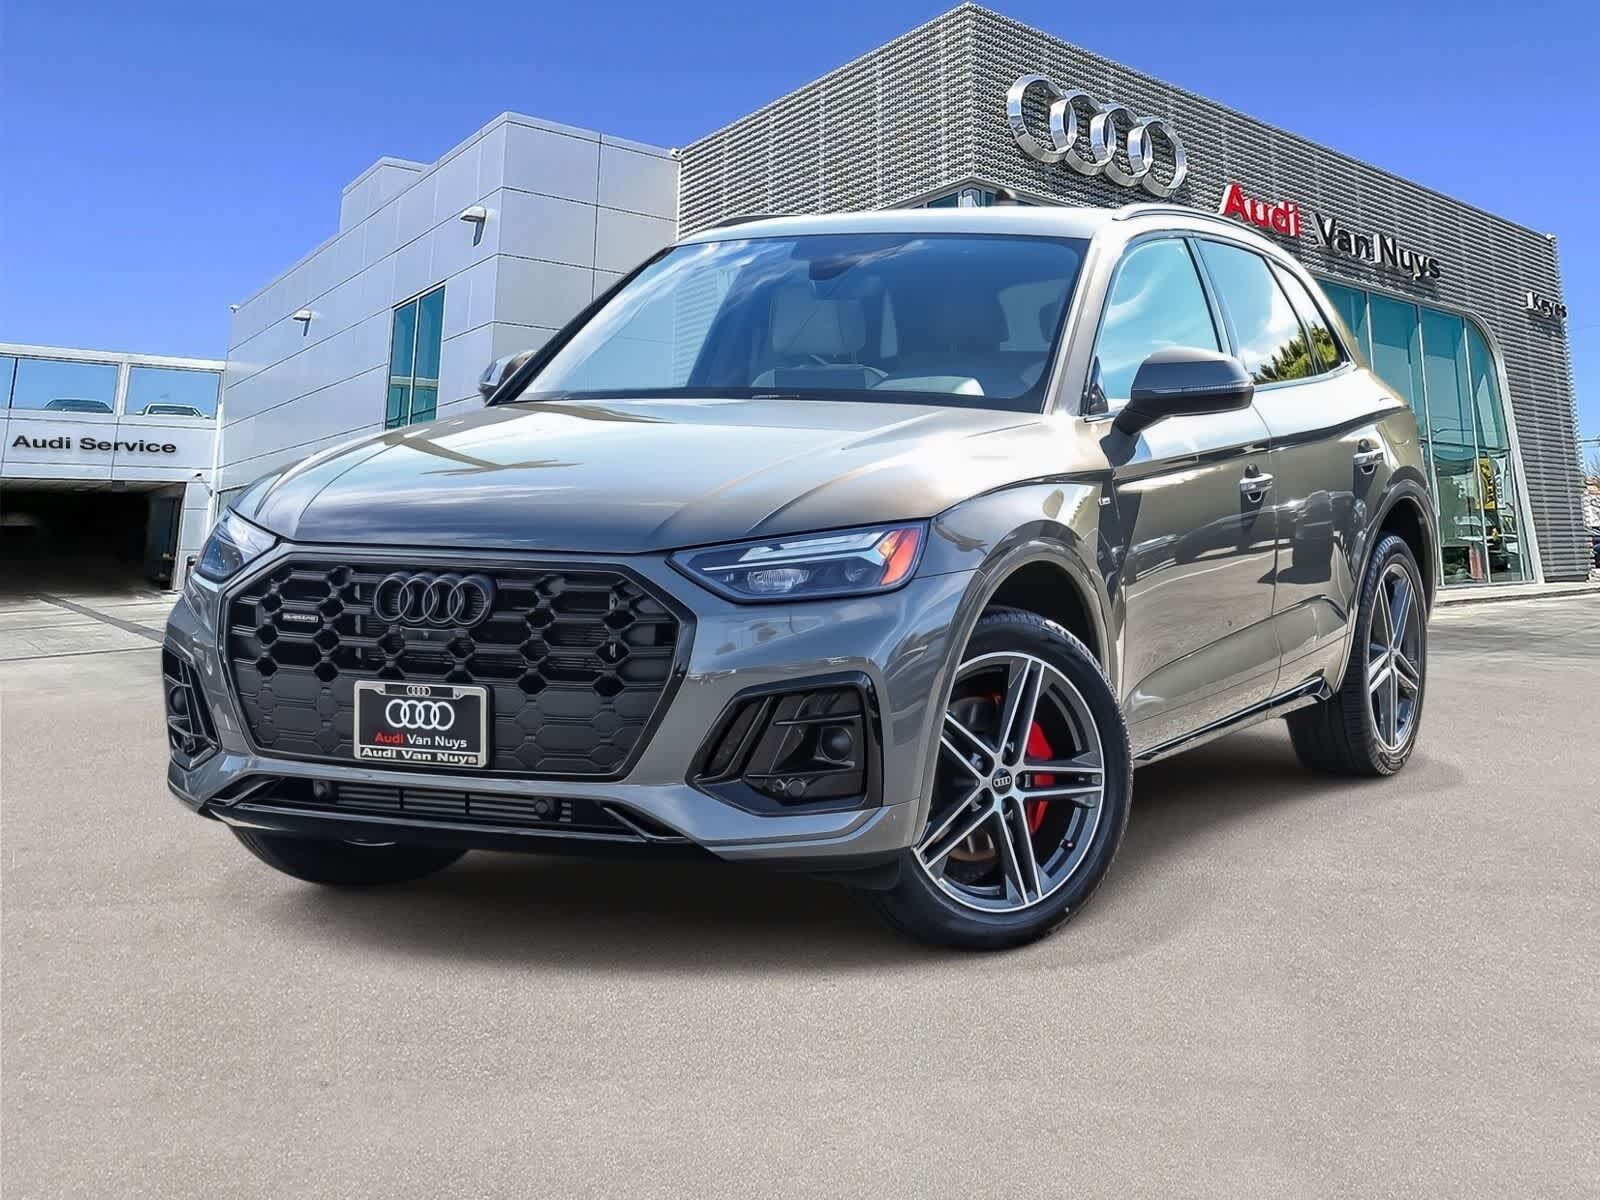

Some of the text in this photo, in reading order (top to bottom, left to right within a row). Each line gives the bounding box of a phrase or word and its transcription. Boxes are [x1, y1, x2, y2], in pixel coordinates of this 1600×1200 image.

[1222, 183, 1441, 280] Audi Van Nuys
[12, 435, 177, 453] Audi Service
[375, 732, 468, 749] Audi Van Nuys
[362, 747, 477, 765] Audi Van Nuys
